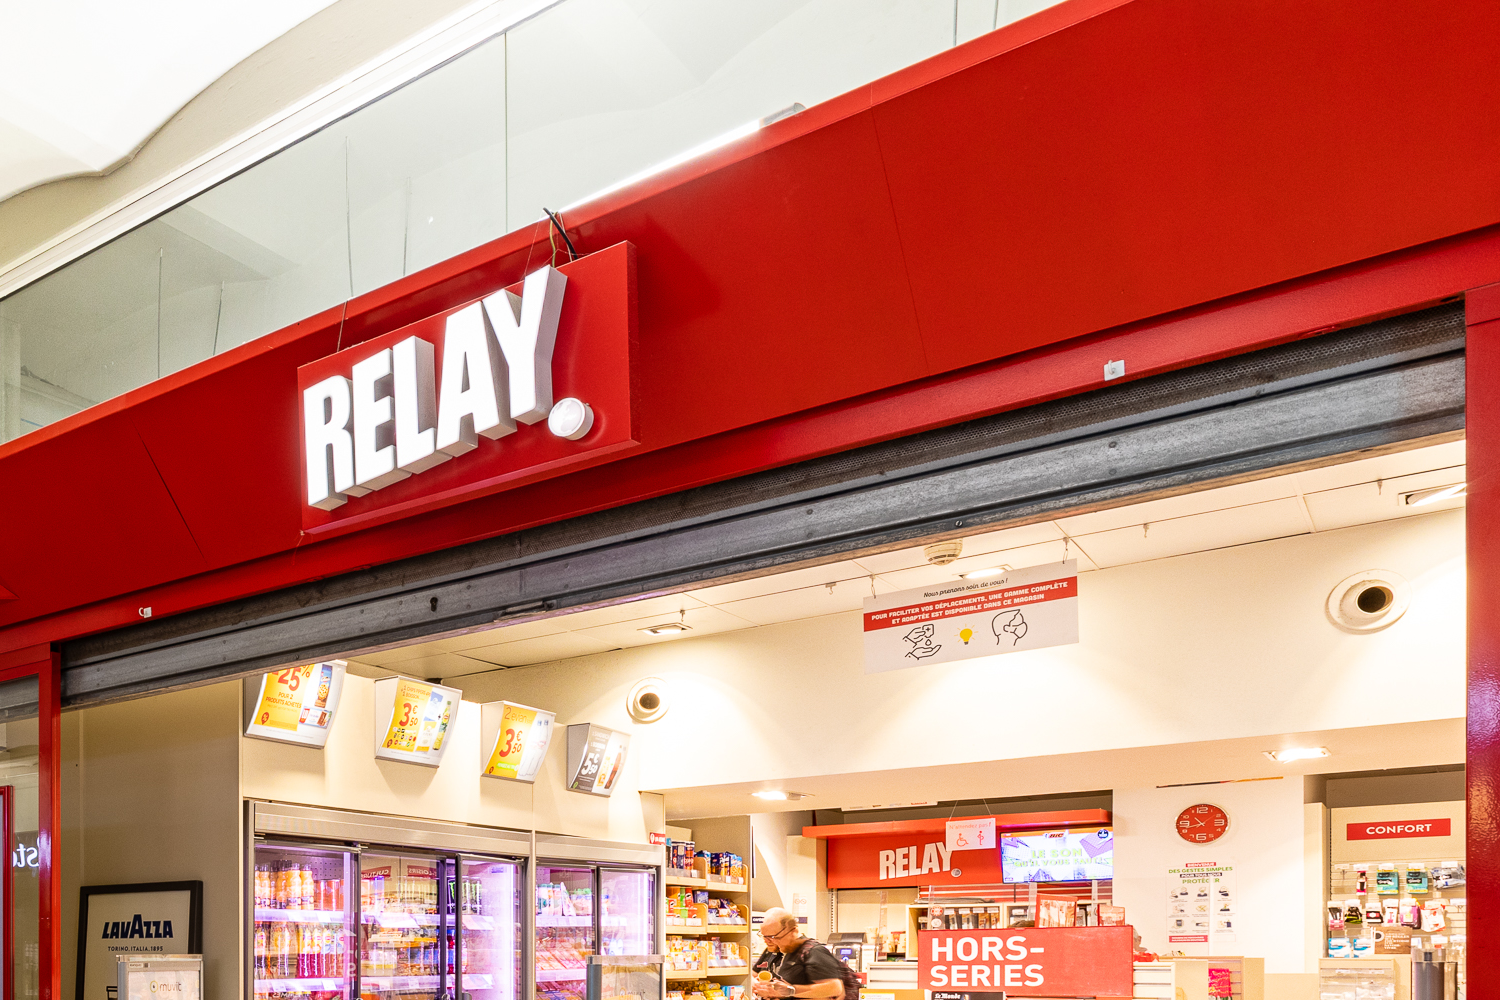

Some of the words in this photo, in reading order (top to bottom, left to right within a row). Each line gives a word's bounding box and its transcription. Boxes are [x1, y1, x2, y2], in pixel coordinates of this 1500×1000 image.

[966, 583, 979, 591] soin
[871, 613, 888, 621] POUR
[888, 607, 920, 618] FACILITER
[921, 604, 934, 612] VOS
[1004, 588, 1030, 598] GAMME
[1030, 581, 1068, 593] COMPLÈTE
[891, 617, 900, 625] ET
[901, 612, 930, 623] ADAPTÉE
[931, 610, 944, 618] EST
[944, 603, 982, 616] DISPONIBLE
[983, 600, 1002, 609] DANS
[1013, 593, 1045, 604] MAGASIN
[278, 691, 288, 699] POUR
[265, 696, 284, 706] PRODUITS
[1214, 819, 1225, 827] 3
[1365, 823, 1432, 835] CONFORT
[1196, 833, 1207, 841] 6
[1032, 850, 1046, 859] LE
[1050, 848, 1082, 858] SON
[1042, 858, 1070, 866] VOUS
[101, 914, 174, 939] LAVAZZA
[931, 936, 1045, 962] HORS-
[930, 964, 1045, 987] SERIES
[159, 982, 182, 992] muvit
